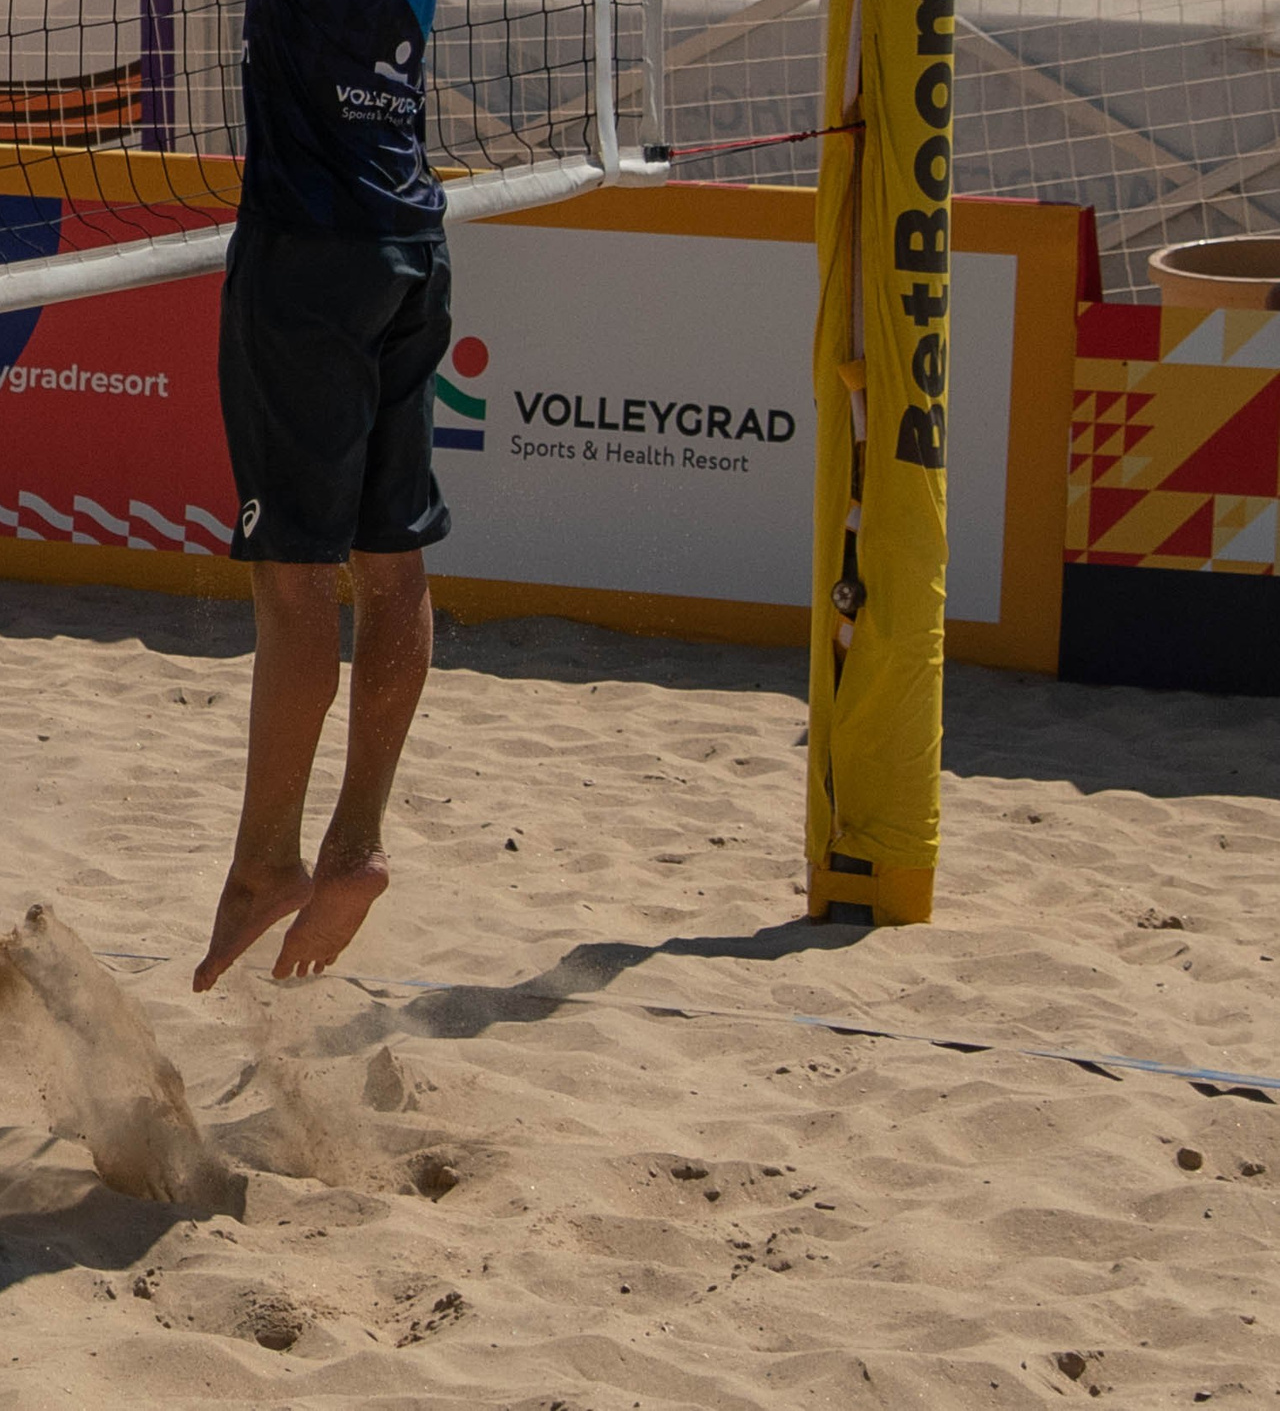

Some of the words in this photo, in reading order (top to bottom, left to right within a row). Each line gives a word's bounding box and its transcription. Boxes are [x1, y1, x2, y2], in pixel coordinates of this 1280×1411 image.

[514, 391, 797, 444] VOLLEYGRAD
[510, 435, 576, 461] Sports
[582, 440, 599, 462] &
[606, 443, 675, 469] Health
[682, 448, 750, 473] Resort
